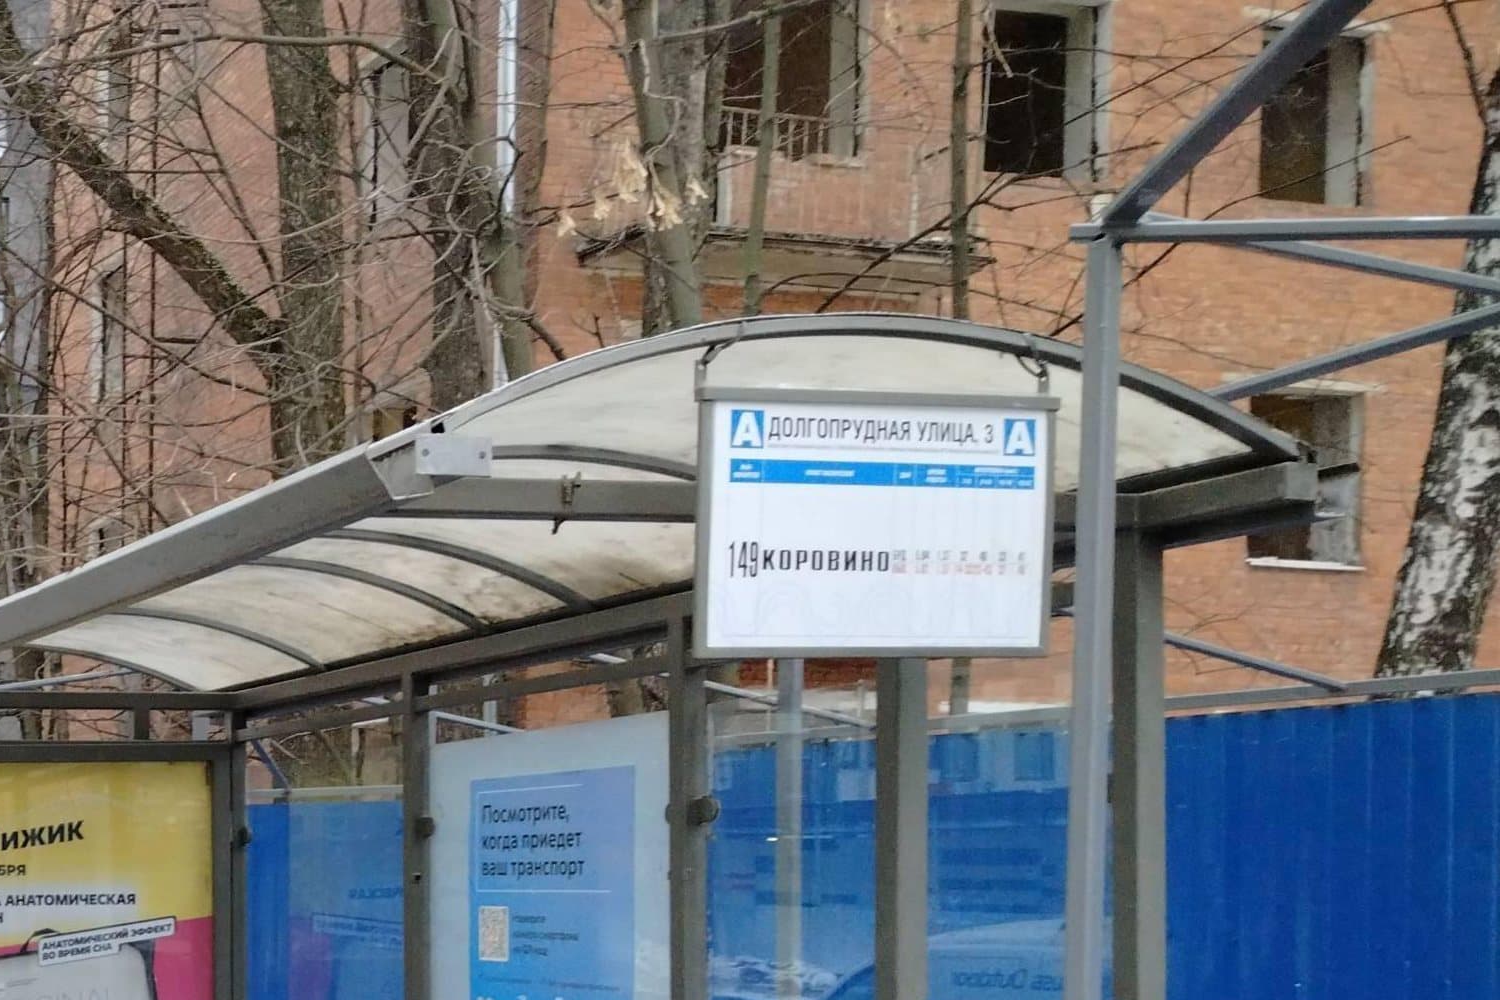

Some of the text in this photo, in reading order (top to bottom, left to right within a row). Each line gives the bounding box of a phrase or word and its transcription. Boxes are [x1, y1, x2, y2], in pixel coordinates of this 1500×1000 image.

[731, 411, 763, 447] А
[768, 416, 911, 443] ДОЛГОПРУДНАЯ
[984, 424, 994, 443] 3
[1004, 420, 1035, 455] А
[728, 541, 759, 578] 149
[762, 549, 889, 572] КОРОВИНО
[482, 804, 569, 826] Посмотрите,
[482, 831, 583, 853] когда приедет
[482, 860, 585, 881] ваш транспорт
[5, 894, 137, 906] АНАТОМИЧЕСКАЯ
[42, 923, 172, 951] АНАТОМИЧЕСКИЙ ЭФФЕКТ
[58, 945, 91, 958] ВРЕМЯ
